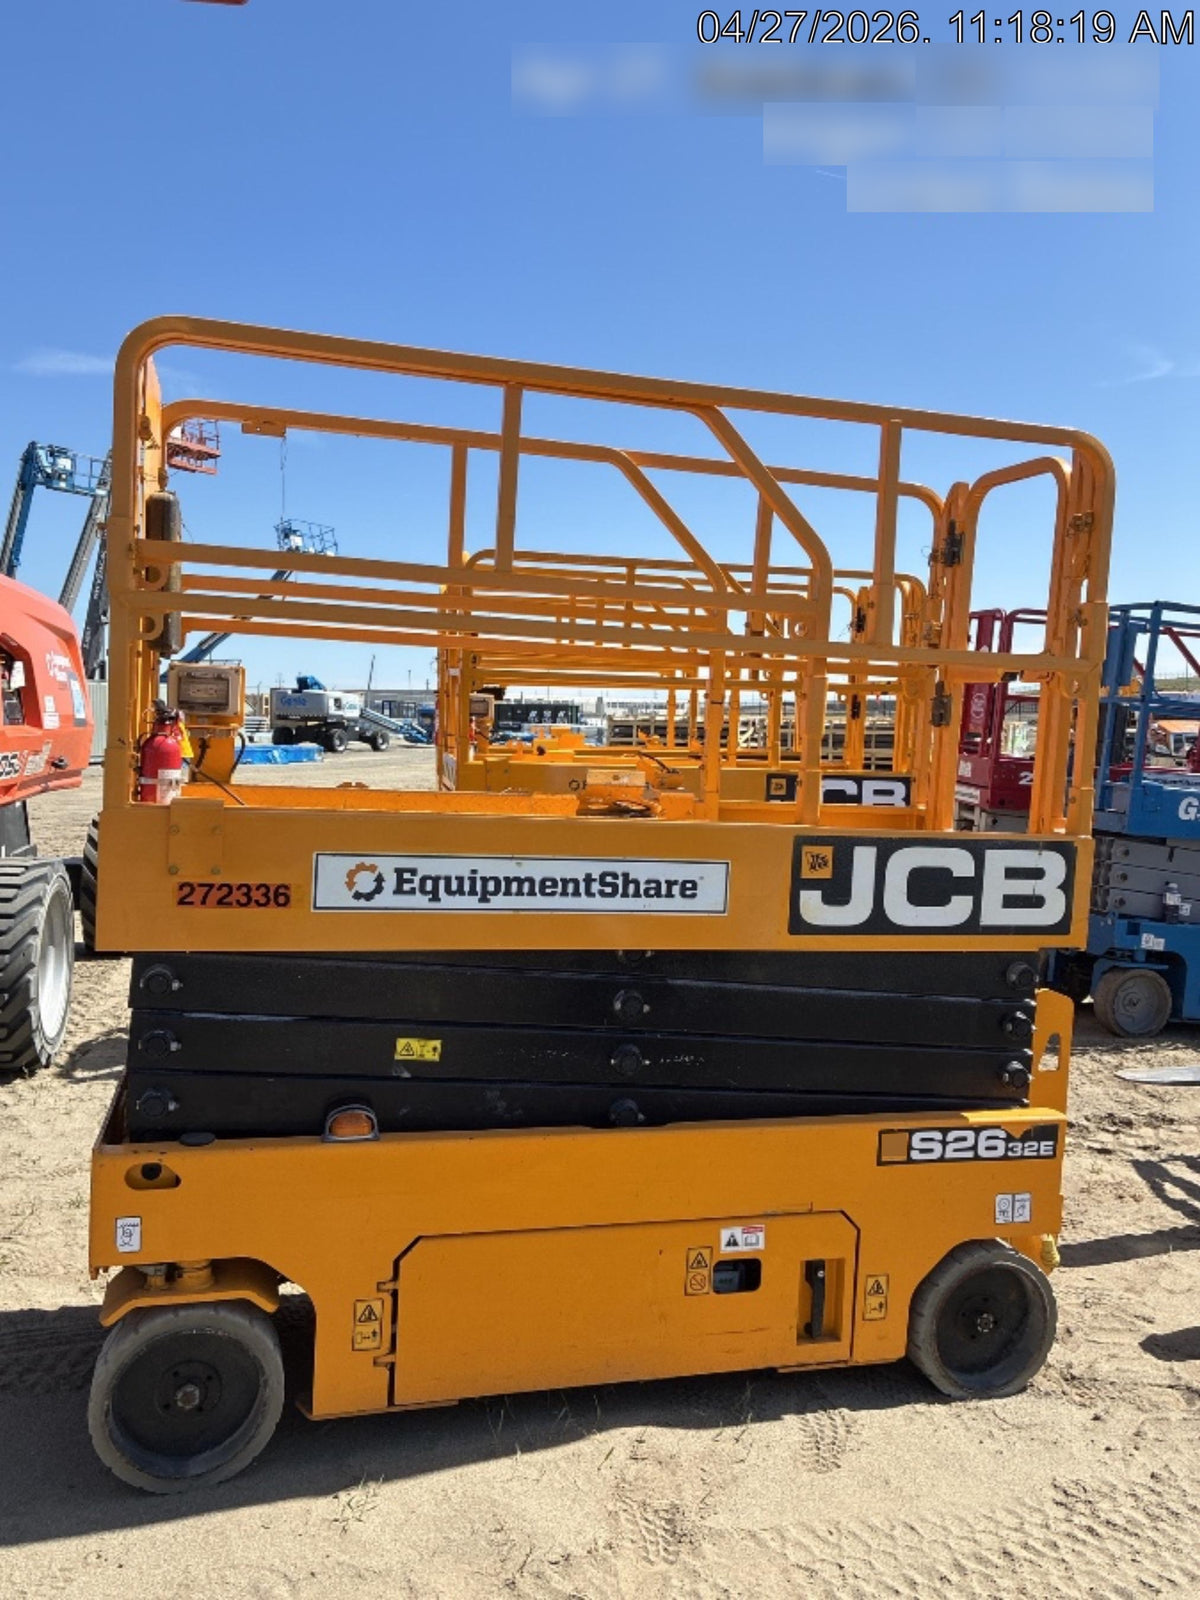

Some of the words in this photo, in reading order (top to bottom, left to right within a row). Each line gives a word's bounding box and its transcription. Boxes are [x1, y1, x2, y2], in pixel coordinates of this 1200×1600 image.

[177, 881, 291, 908] 272336
[393, 866, 698, 903] EquipmentShare
[800, 845, 1067, 927] JCB
